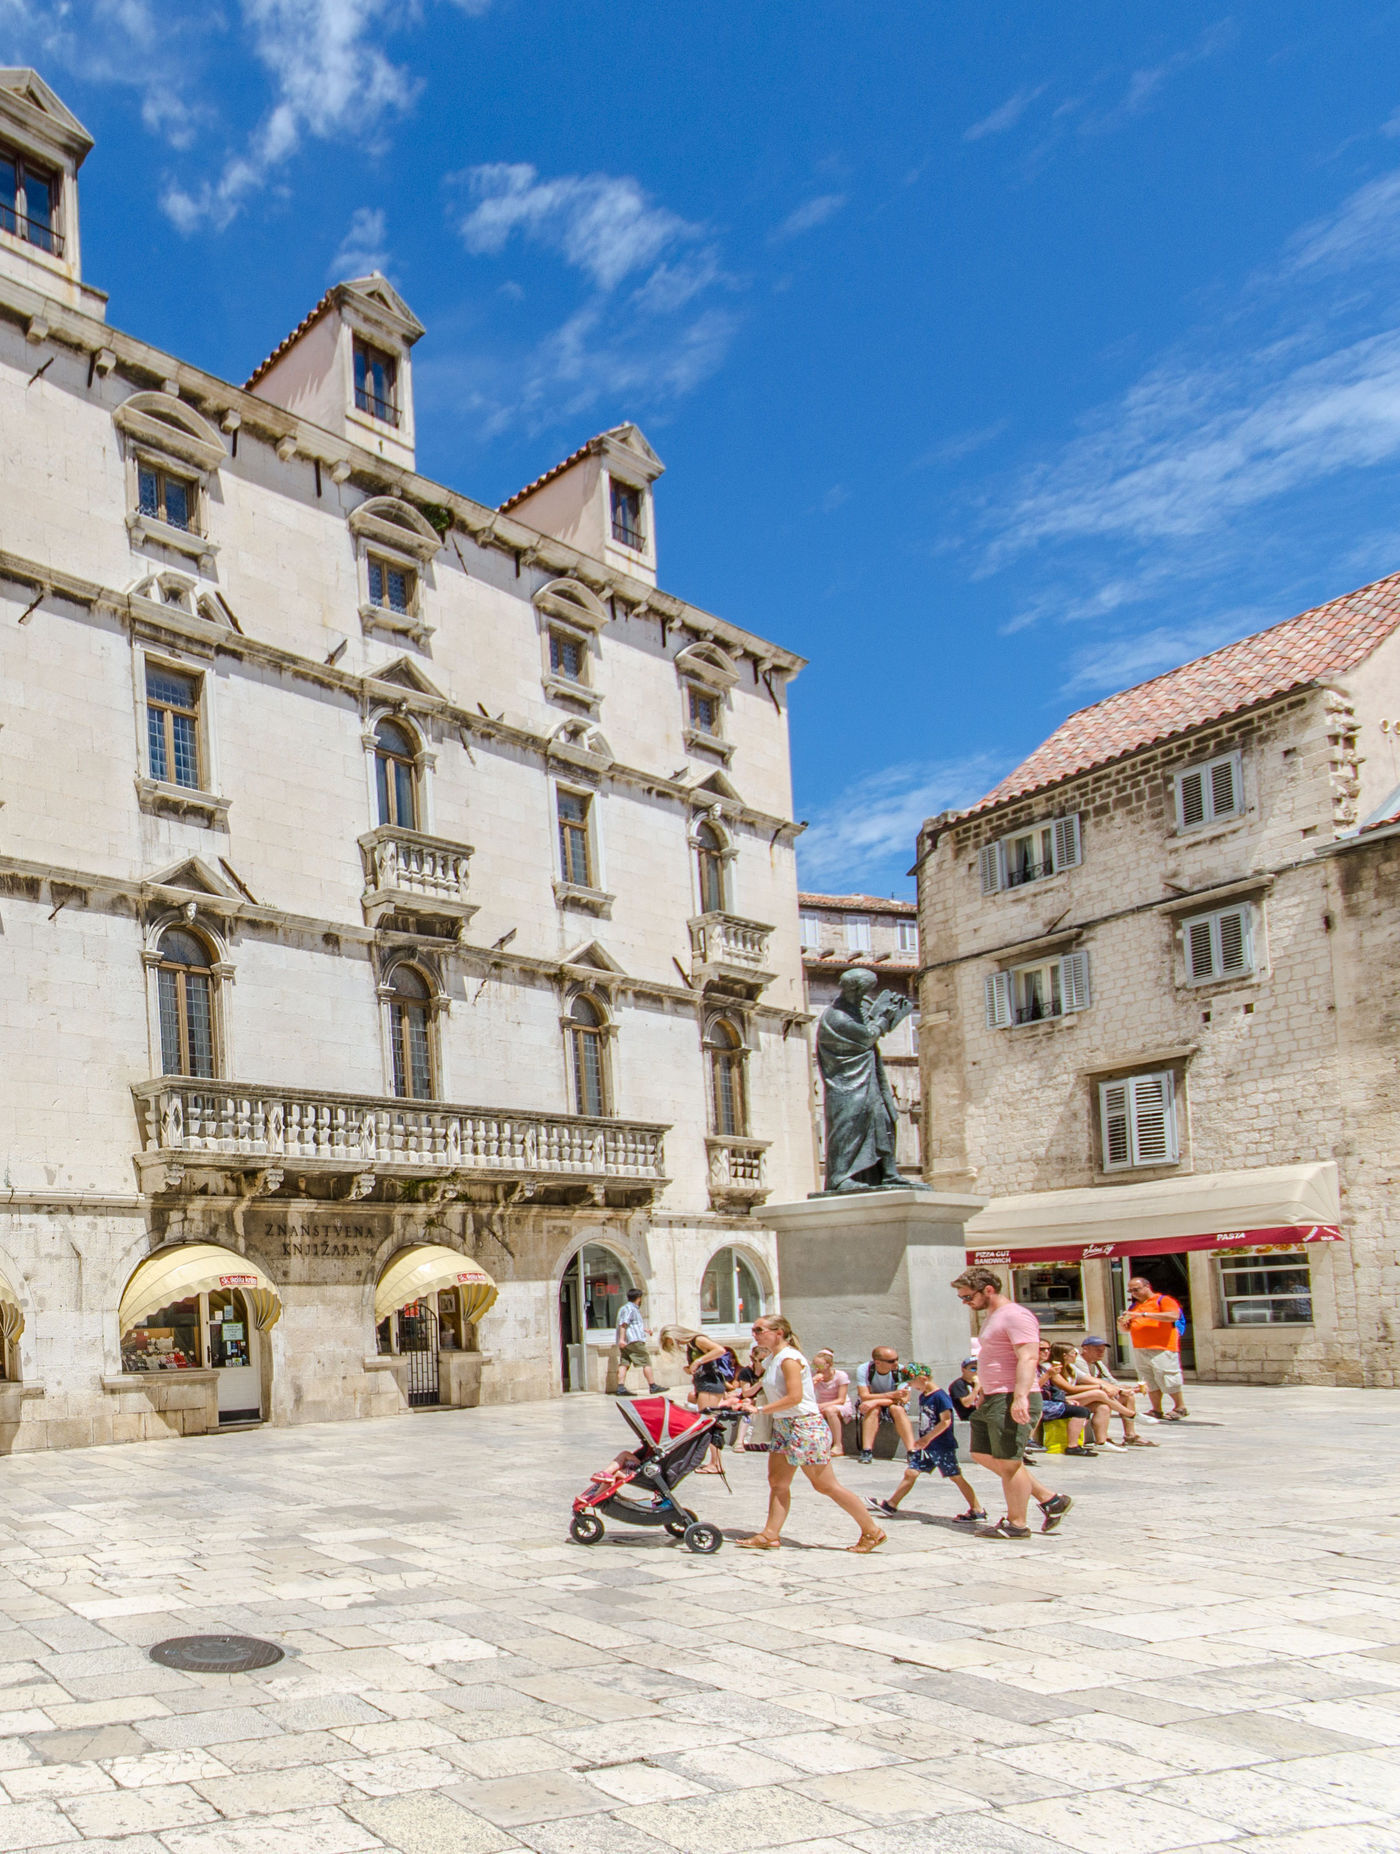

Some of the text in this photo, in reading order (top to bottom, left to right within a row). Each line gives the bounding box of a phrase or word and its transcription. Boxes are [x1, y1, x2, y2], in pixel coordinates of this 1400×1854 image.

[264, 1223, 375, 1238] ZNANSTVENA
[1216, 1232, 1246, 1241] PASTA
[282, 1241, 360, 1256] KNJIŽARA
[974, 1257, 1011, 1265] SANDWICH
